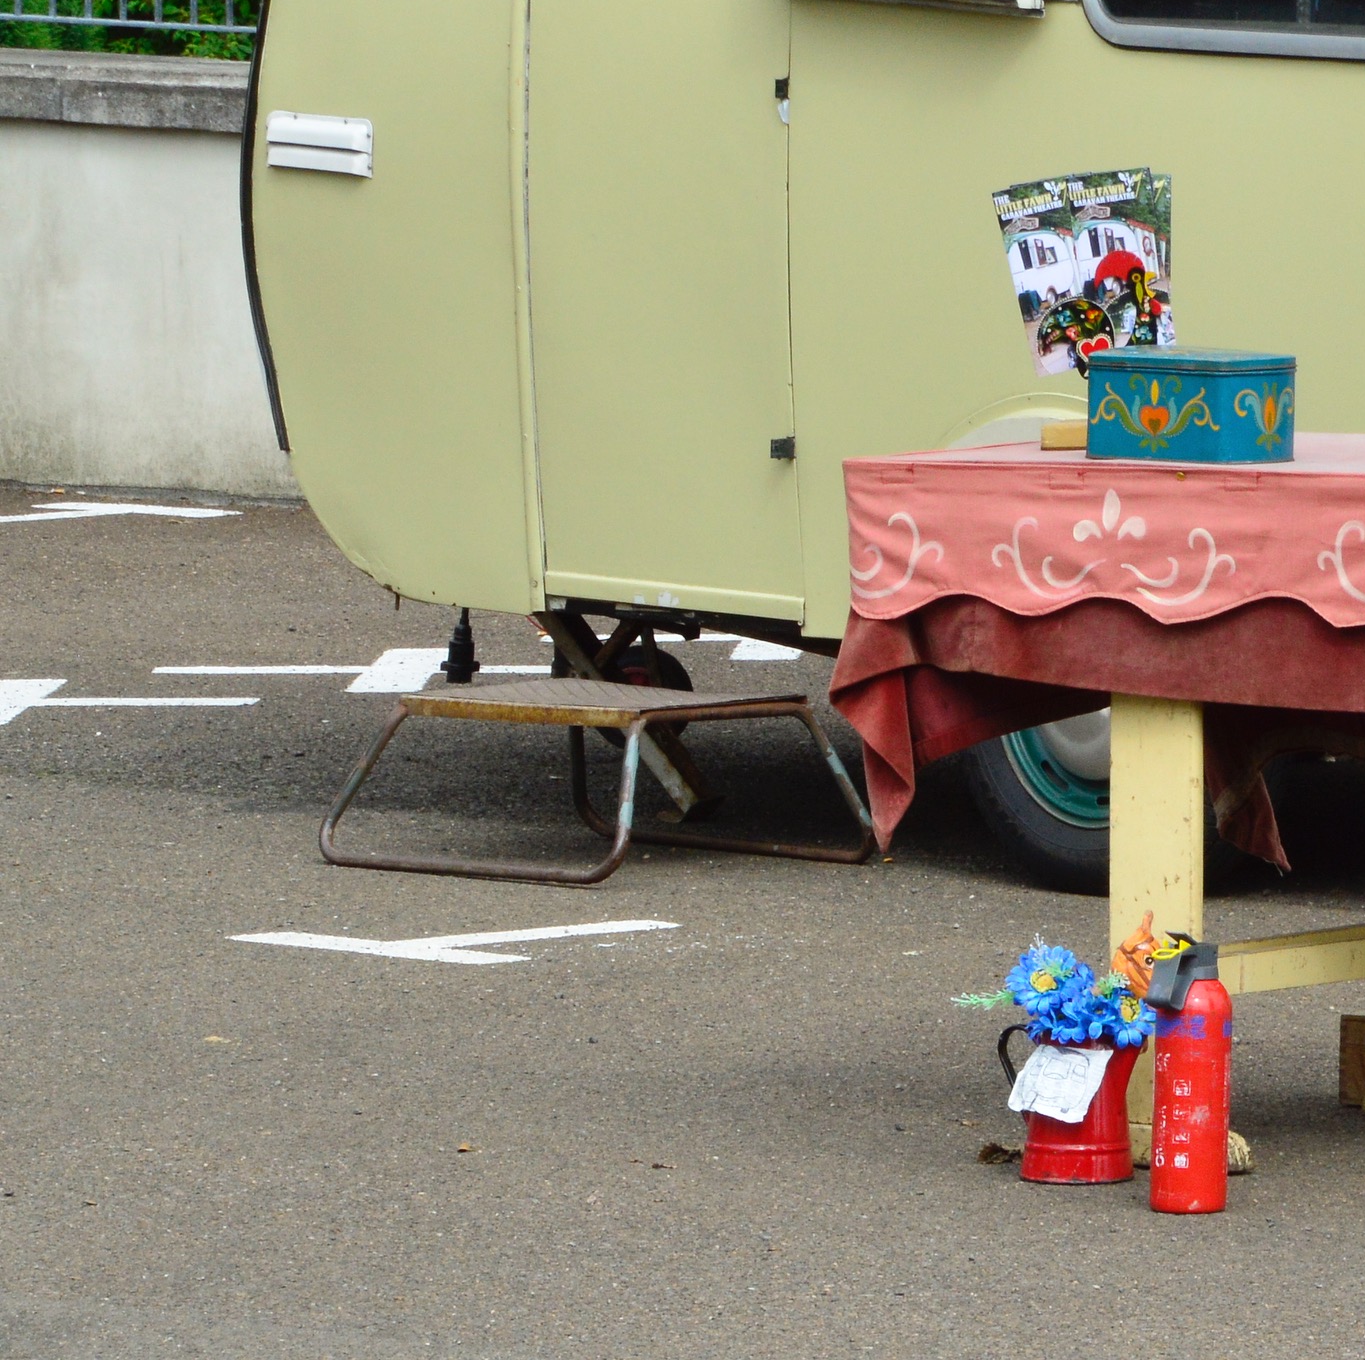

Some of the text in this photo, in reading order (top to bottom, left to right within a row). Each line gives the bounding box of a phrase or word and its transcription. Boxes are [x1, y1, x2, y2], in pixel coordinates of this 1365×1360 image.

[1067, 181, 1084, 192] THE
[1069, 183, 1126, 201] LITTLE FAWN
[994, 194, 1010, 206] THE
[996, 192, 1051, 215] LITTLE FAWN
[1073, 192, 1135, 207] CARAVAN THEATRE
[1001, 208, 1033, 221] CARAVAN
[1034, 200, 1063, 213] THEATRE
